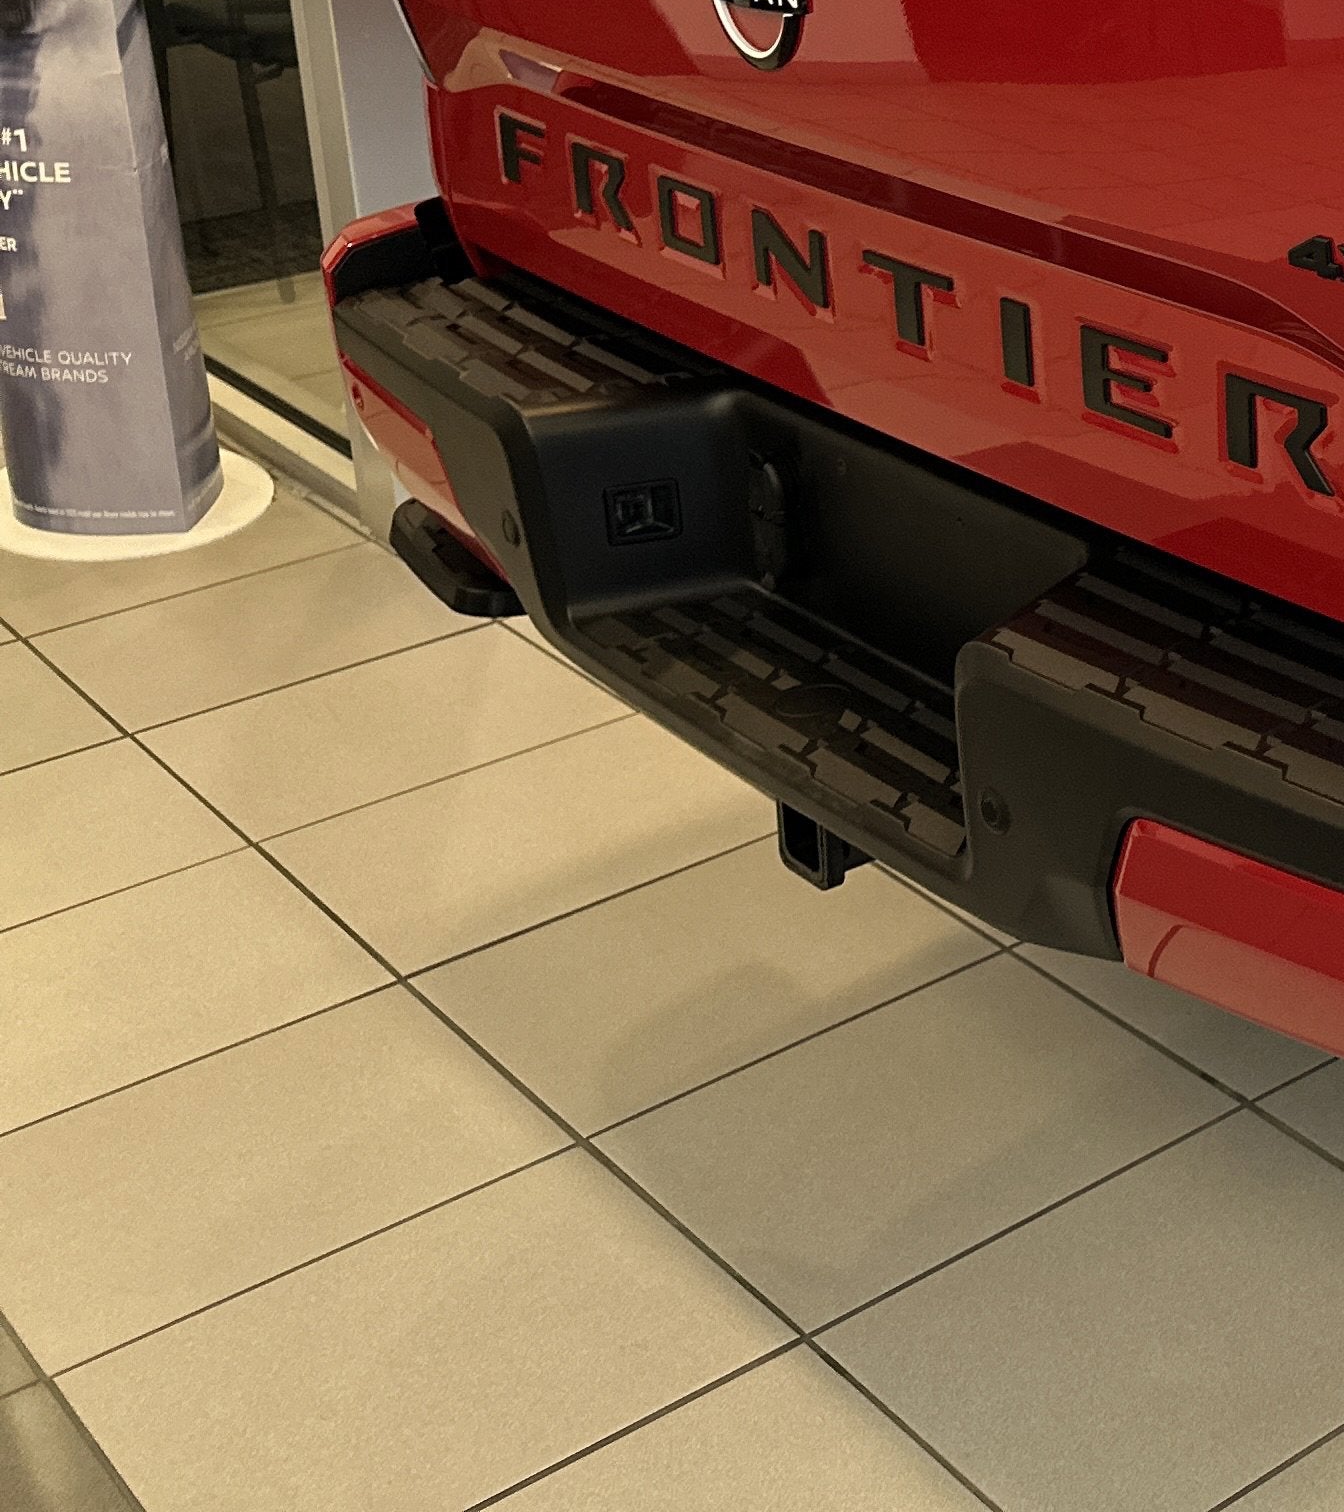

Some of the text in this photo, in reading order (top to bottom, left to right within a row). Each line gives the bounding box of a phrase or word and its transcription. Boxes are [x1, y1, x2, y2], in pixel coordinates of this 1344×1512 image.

[496, 108, 1342, 499] FRONTIER
[57, 350, 133, 366] QUALITY
[40, 368, 110, 384] BRANDS
